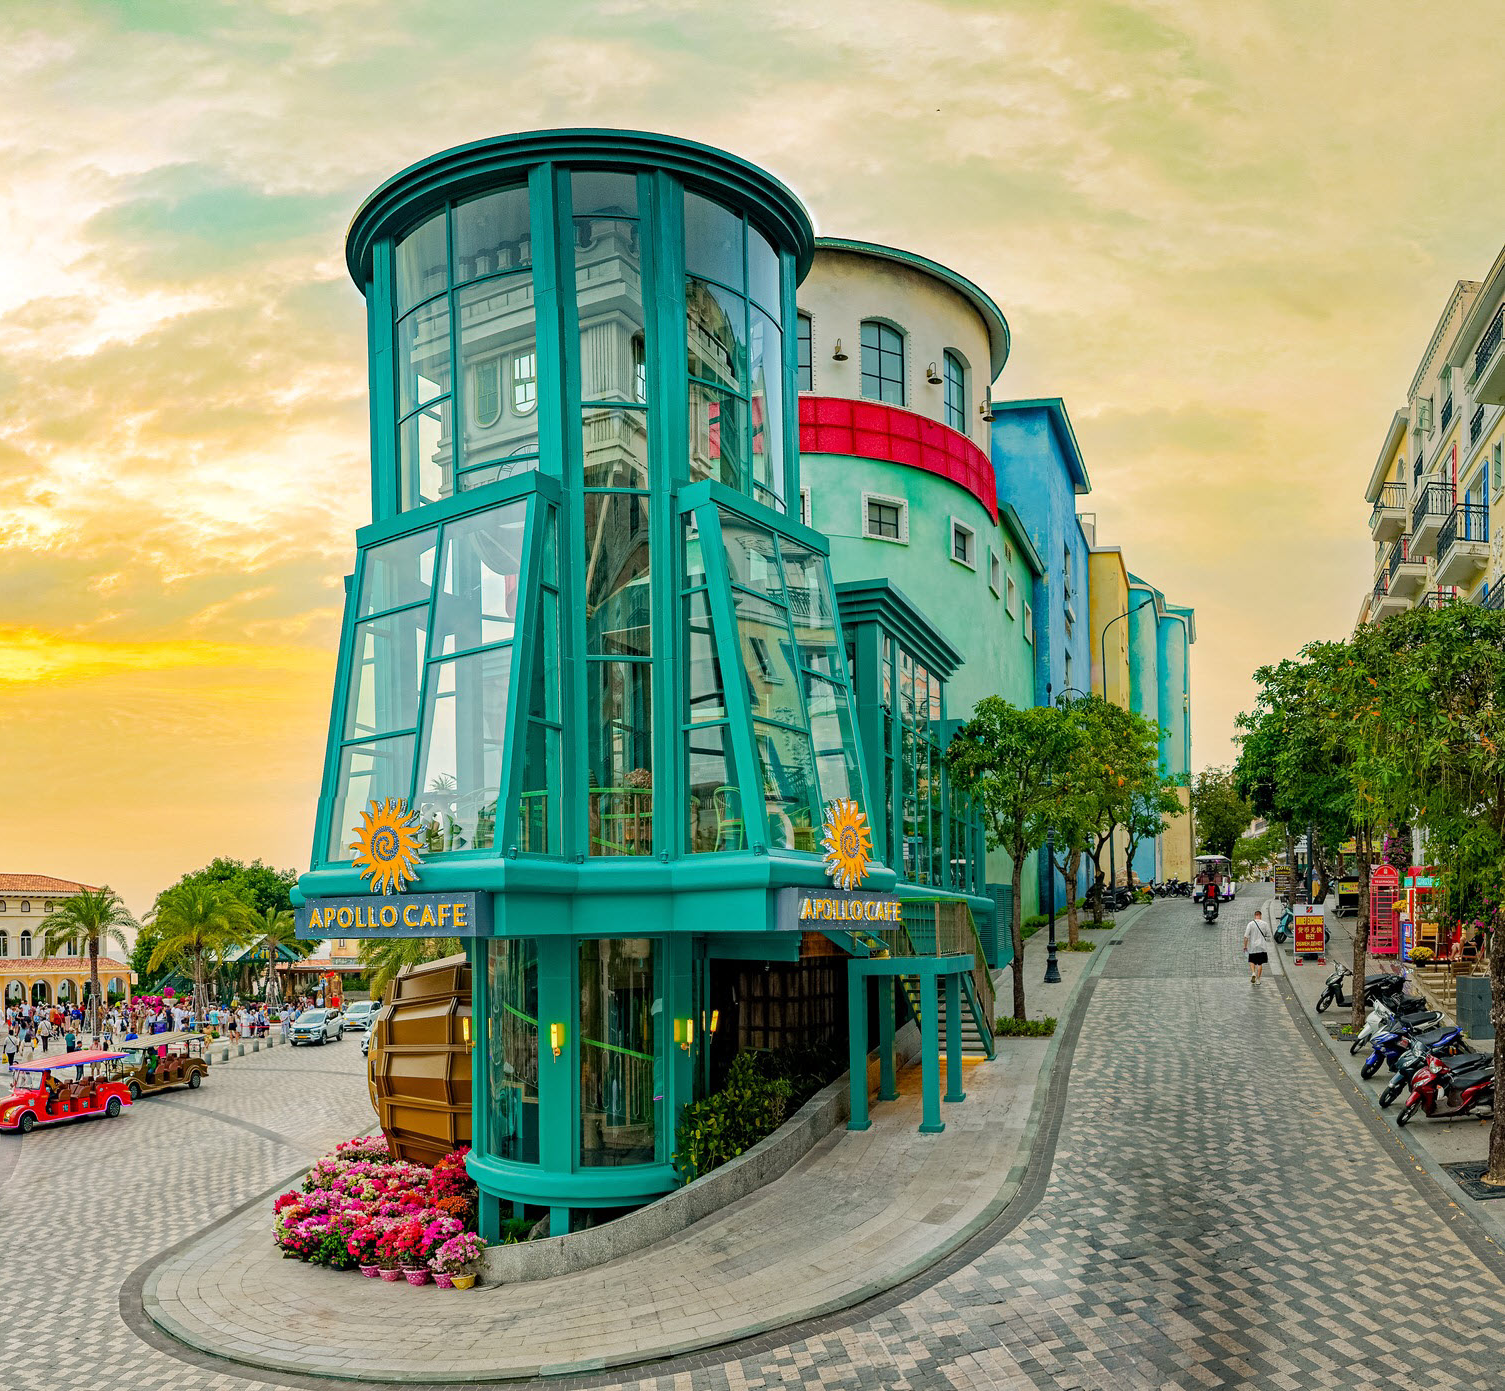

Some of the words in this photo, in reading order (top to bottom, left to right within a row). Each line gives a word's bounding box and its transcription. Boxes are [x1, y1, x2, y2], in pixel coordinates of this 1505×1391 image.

[308, 905, 398, 928] APOLLO
[402, 903, 468, 927] CAFE
[800, 898, 863, 921] APOLLO
[864, 901, 903, 922] CAFE
